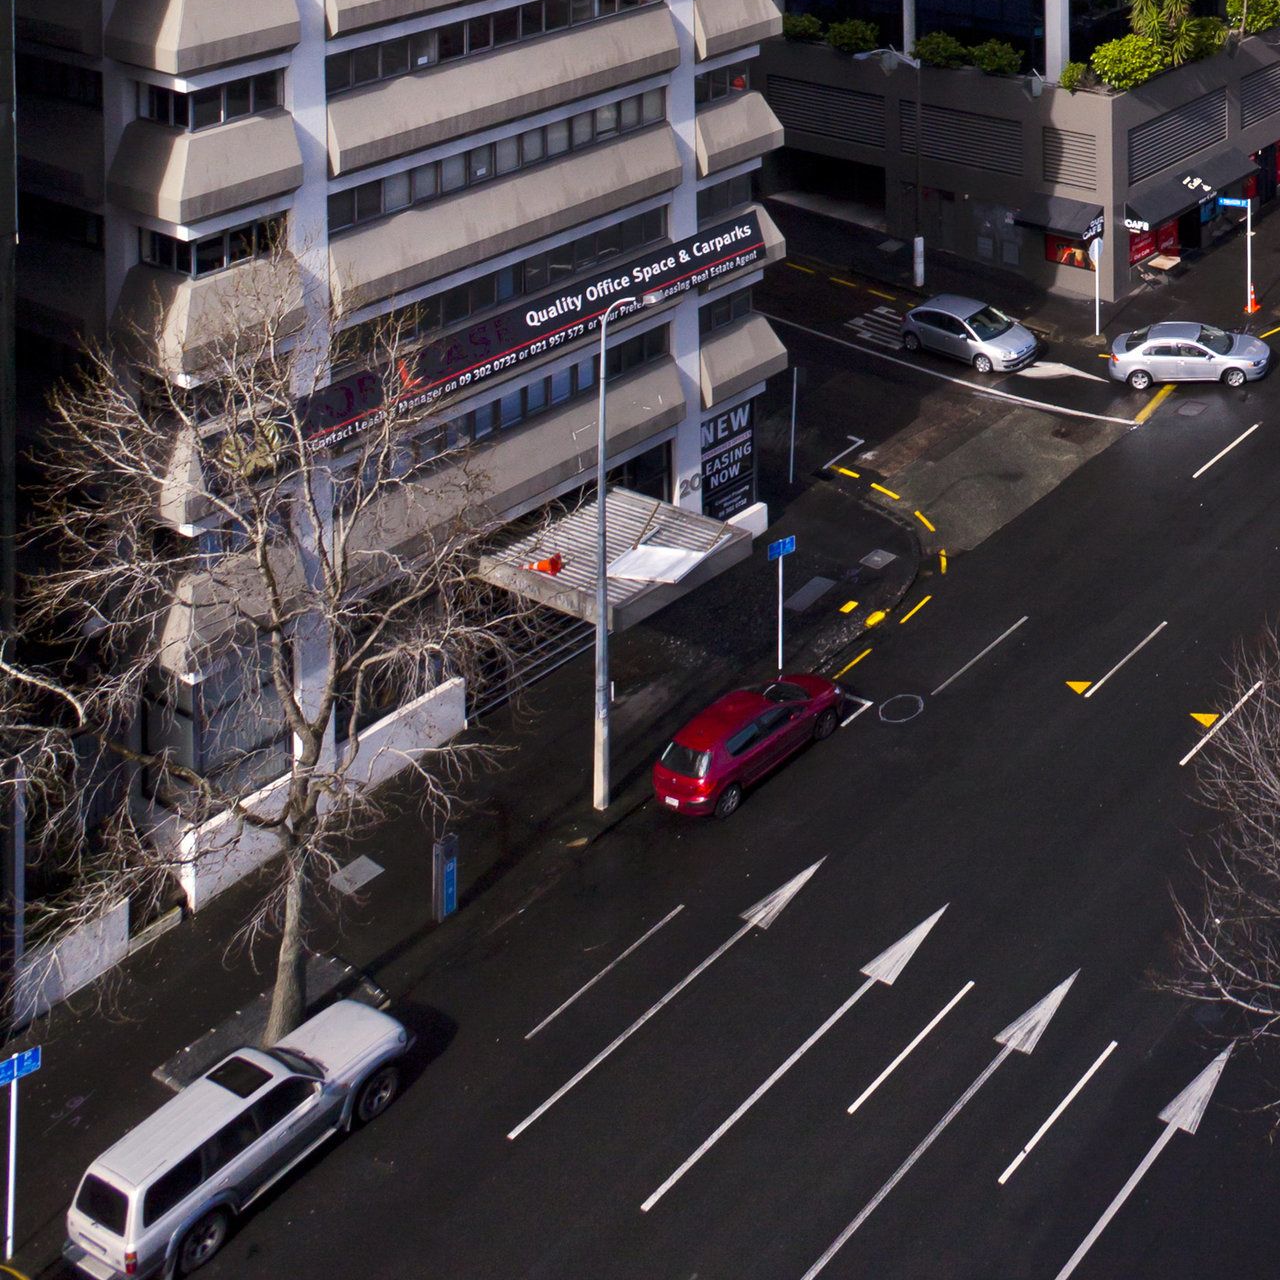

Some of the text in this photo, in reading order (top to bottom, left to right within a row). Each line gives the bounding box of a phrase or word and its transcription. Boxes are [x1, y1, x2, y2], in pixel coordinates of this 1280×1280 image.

[525, 223, 752, 329] Quality Office Space & Carparks
[311, 425, 352, 451] Contact
[398, 387, 444, 414] Manager
[445, 381, 457, 392] on
[459, 373, 471, 386] 09
[474, 365, 491, 379] 302
[494, 354, 517, 371] 0732
[519, 348, 530, 360] or
[531, 340, 547, 355] 021
[549, 332, 566, 348] 957
[568, 324, 584, 339] 573
[588, 318, 598, 330] or
[598, 309, 619, 325] Yur
[691, 271, 709, 286] Real
[710, 261, 735, 278] Estate
[735, 250, 758, 269] Agent
[701, 403, 751, 448] NEW
[702, 441, 752, 478] EASING
[710, 462, 741, 489] NOW
[679, 472, 702, 499] 20
